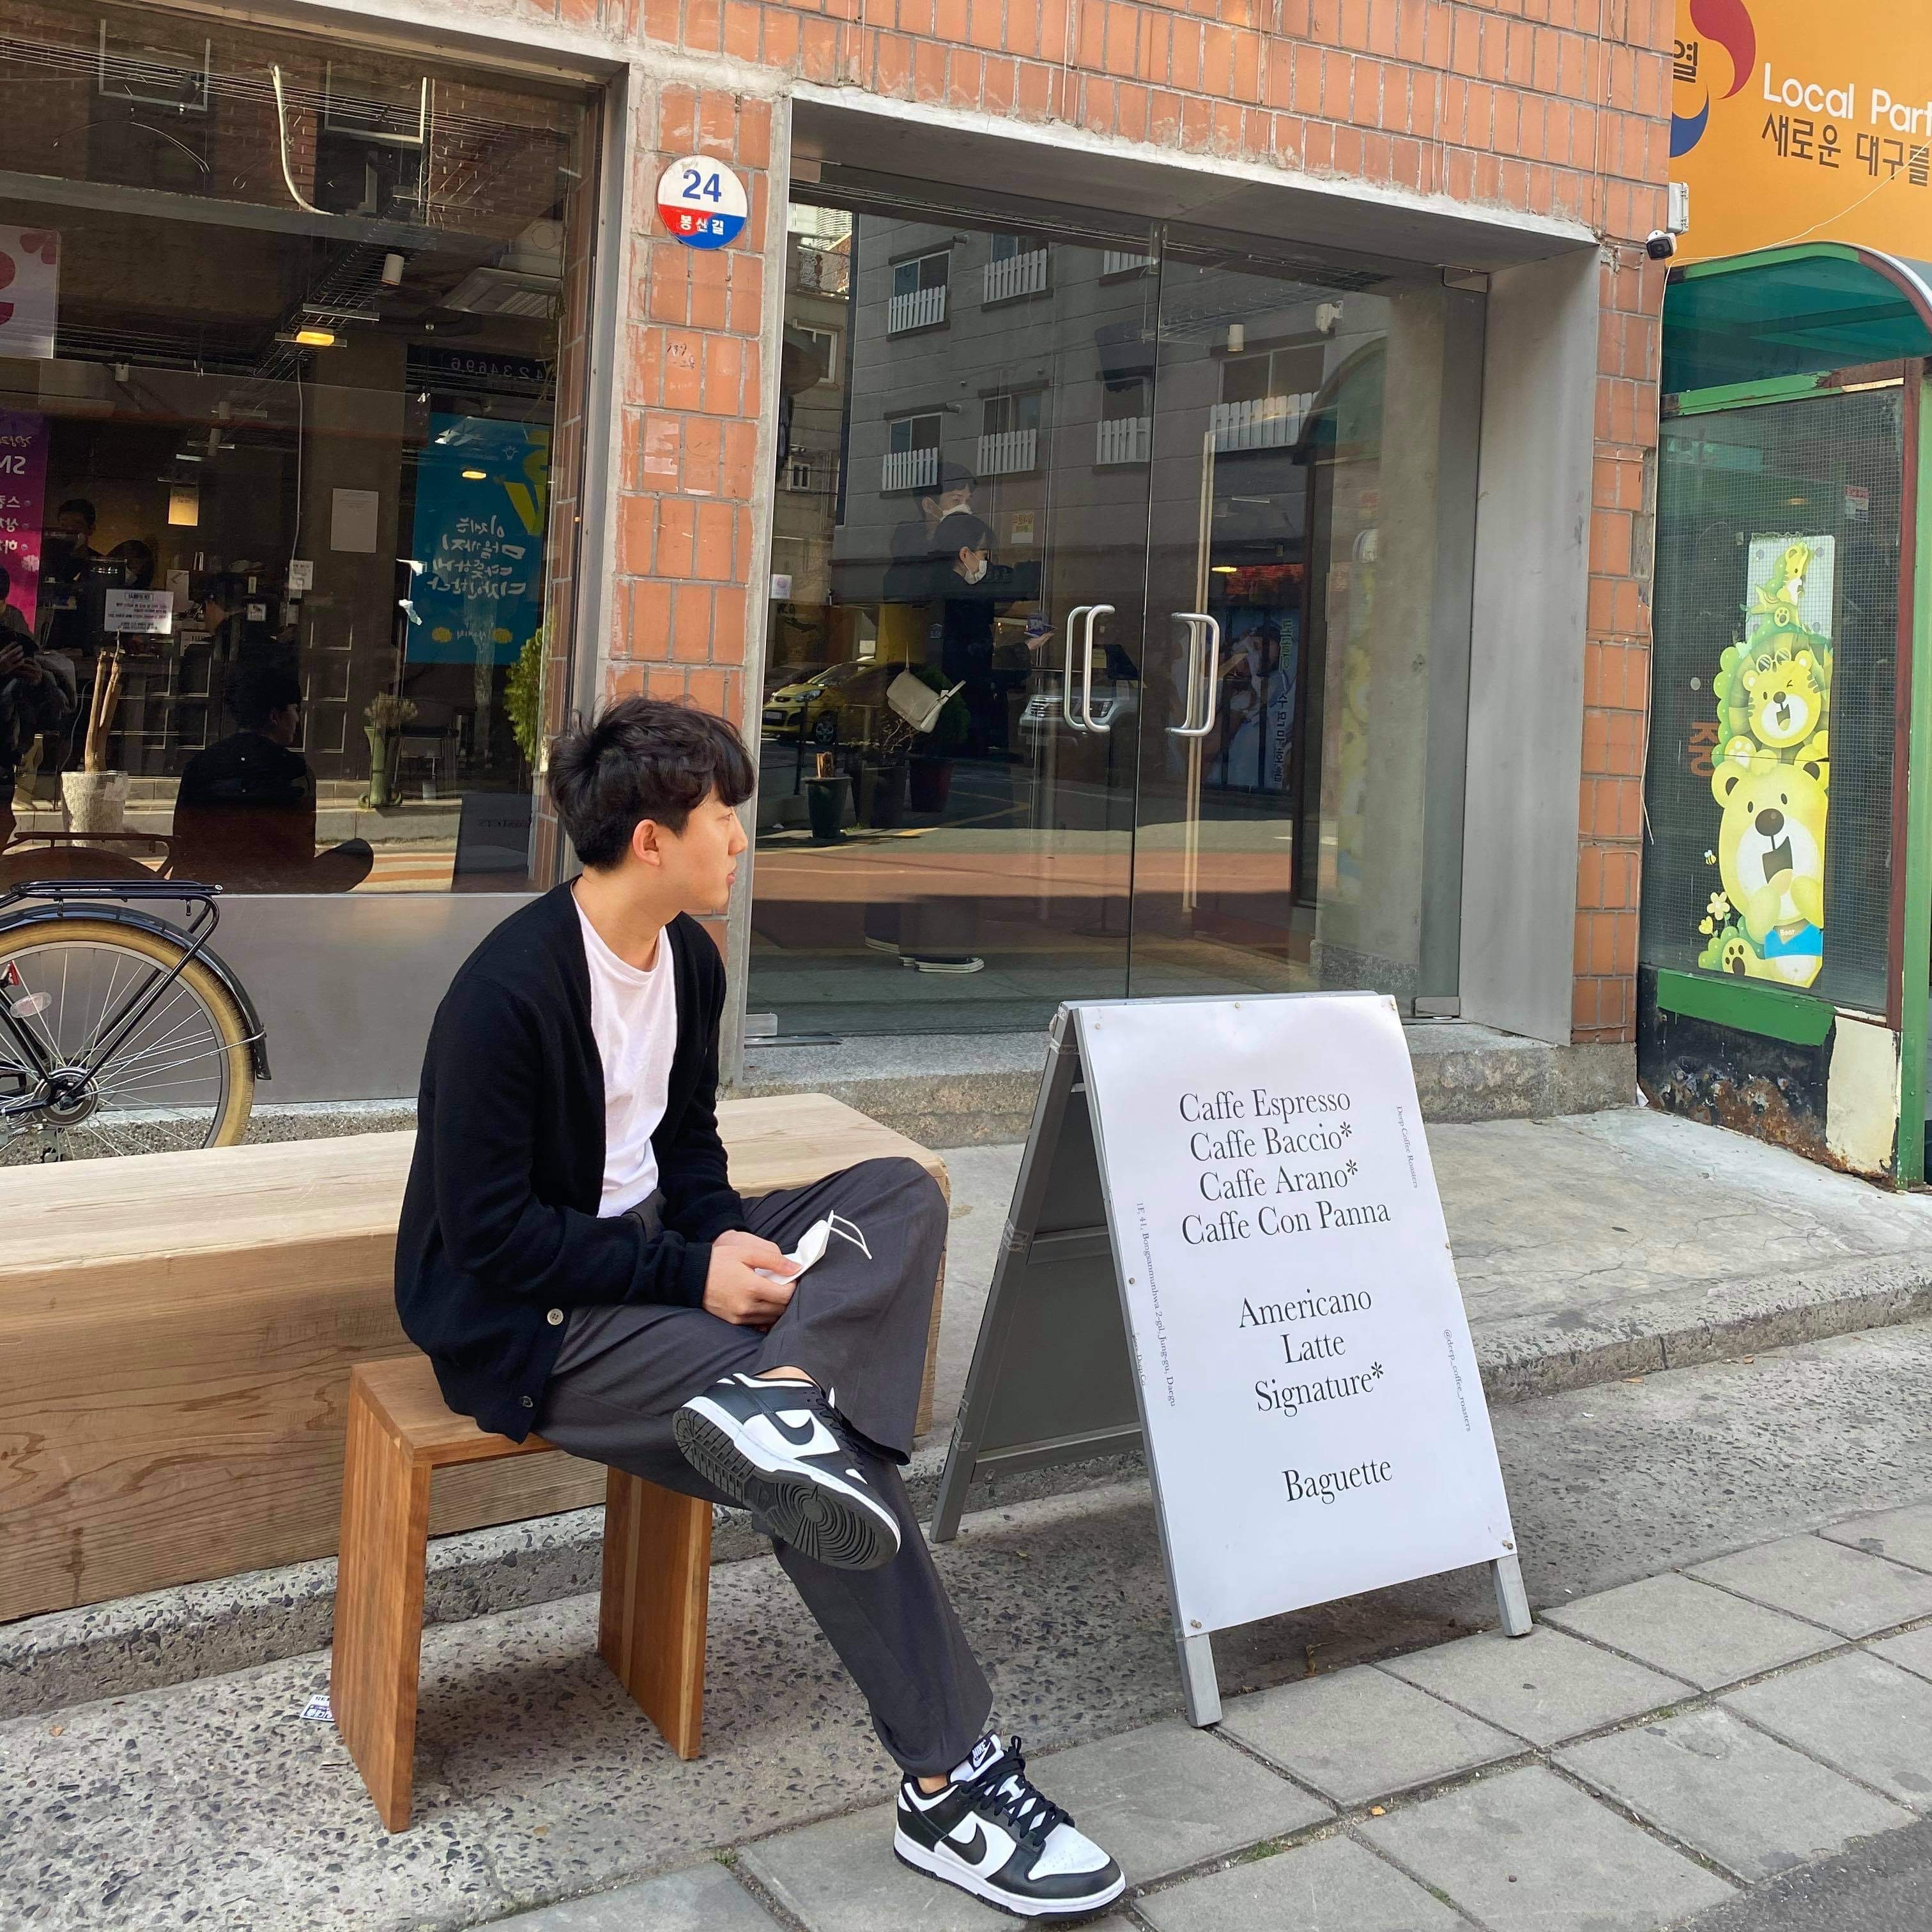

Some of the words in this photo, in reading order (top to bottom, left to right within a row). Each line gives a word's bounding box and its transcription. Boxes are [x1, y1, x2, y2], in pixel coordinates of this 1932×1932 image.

[1763, 63, 1855, 119] Local
[1871, 88, 1932, 137] Part
[1761, 112, 1841, 168] 새로운
[1855, 132, 1931, 187] 대구를
[682, 169, 722, 202] 24
[680, 214, 724, 235] 봉산길
[1779, 928, 1795, 937] Bear
[1179, 1091, 1245, 1123] Caffe
[1252, 1089, 1351, 1124] Espresso
[1190, 1129, 1257, 1162] Caffe
[1396, 1105, 1404, 1127] Deep
[1401, 1128, 1411, 1154] Coffee
[1407, 1154, 1418, 1189] Roasters
[1200, 1168, 1267, 1201] Caffe
[1182, 1210, 1251, 1245] Caffe
[1258, 1206, 1312, 1236] Con
[1315, 1200, 1392, 1229] Panna
[1239, 1288, 1372, 1329] Americano
[1280, 1333, 1346, 1364] Latte
[1166, 1376, 1176, 1407] Daegu
[1282, 1459, 1393, 1505] Baguette
[972, 1739, 986, 1759] NIKE
